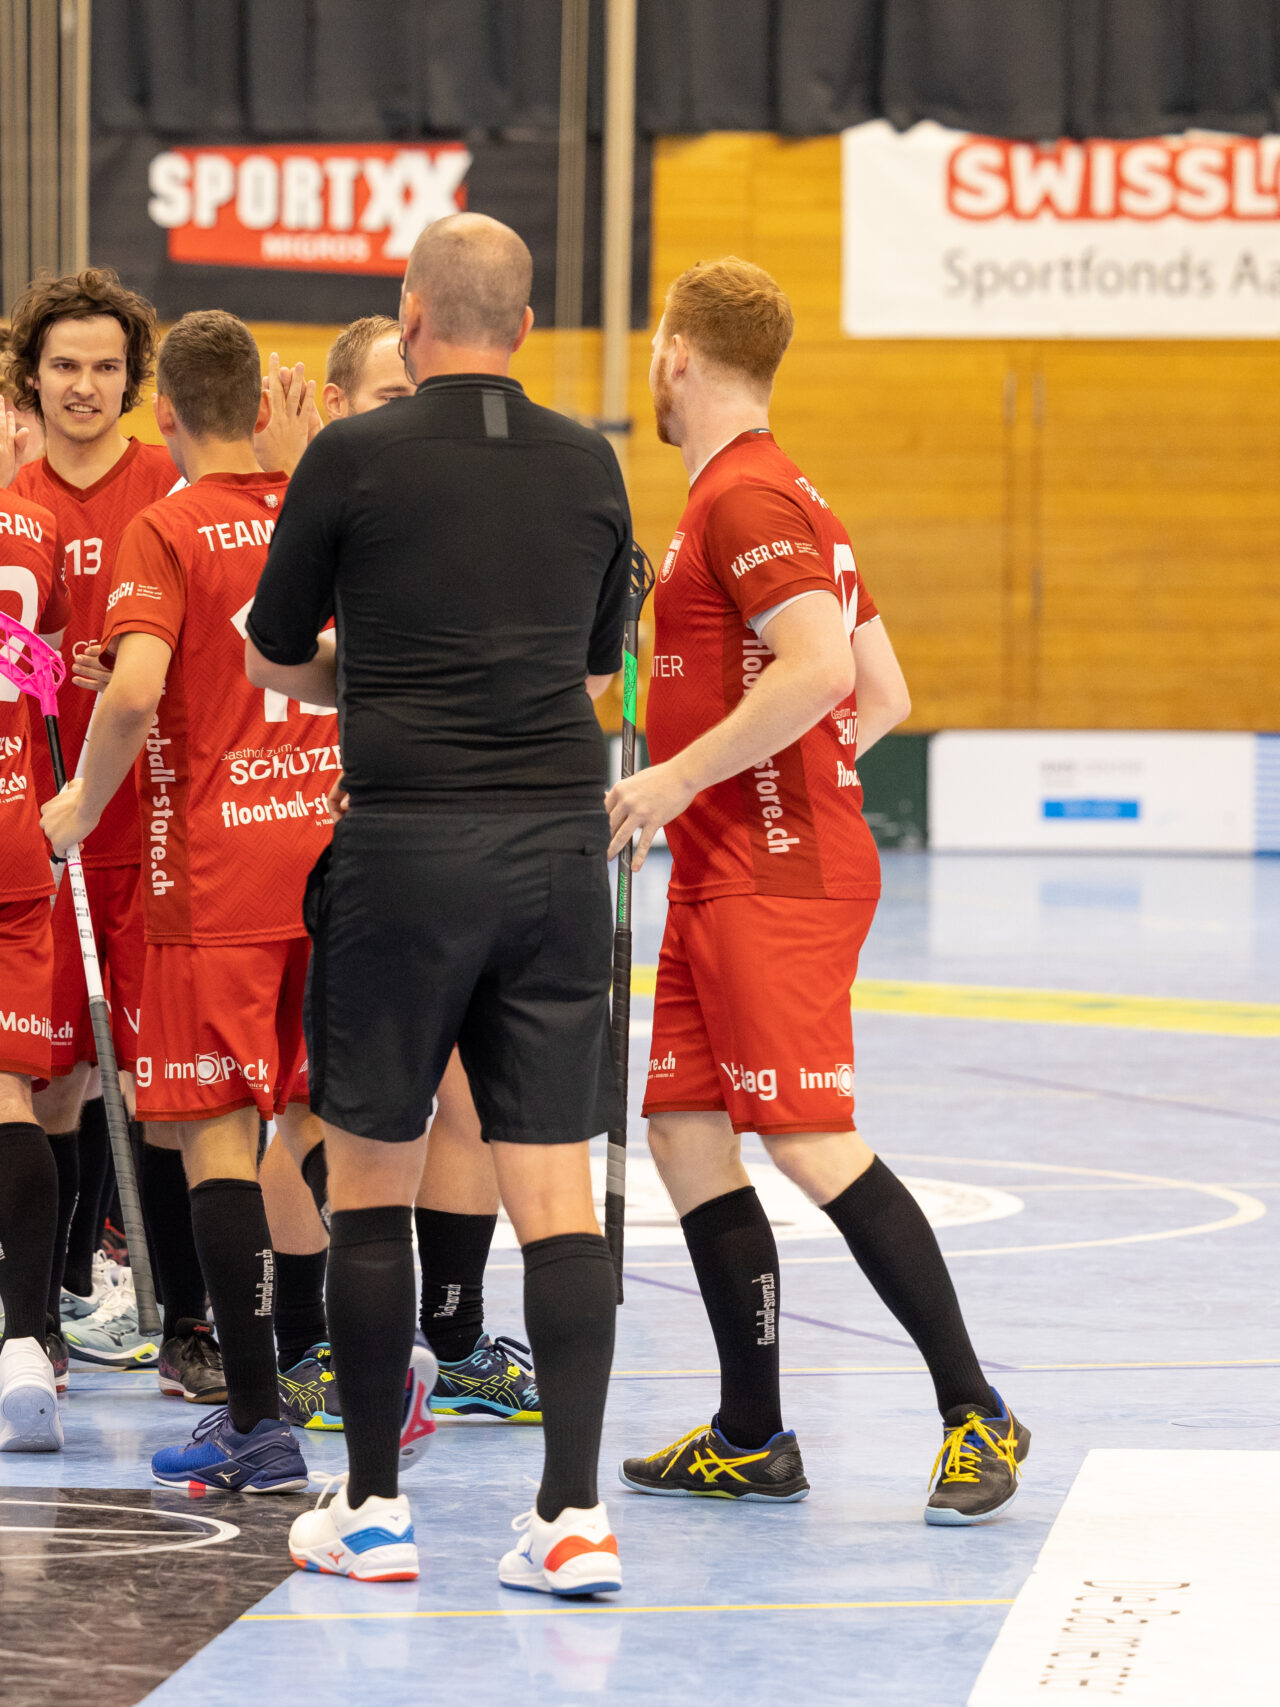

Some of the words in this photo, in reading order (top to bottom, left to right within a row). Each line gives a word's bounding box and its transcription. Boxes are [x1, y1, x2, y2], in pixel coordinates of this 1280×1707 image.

[948, 138, 1280, 221] SWISSL
[943, 245, 1216, 306] Sportfonds
[197, 519, 277, 552] TEAM
[64, 537, 103, 576] 13
[730, 539, 795, 580] KÄSER.CH
[267, 743, 292, 758] zum
[221, 790, 331, 828] floorball-st
